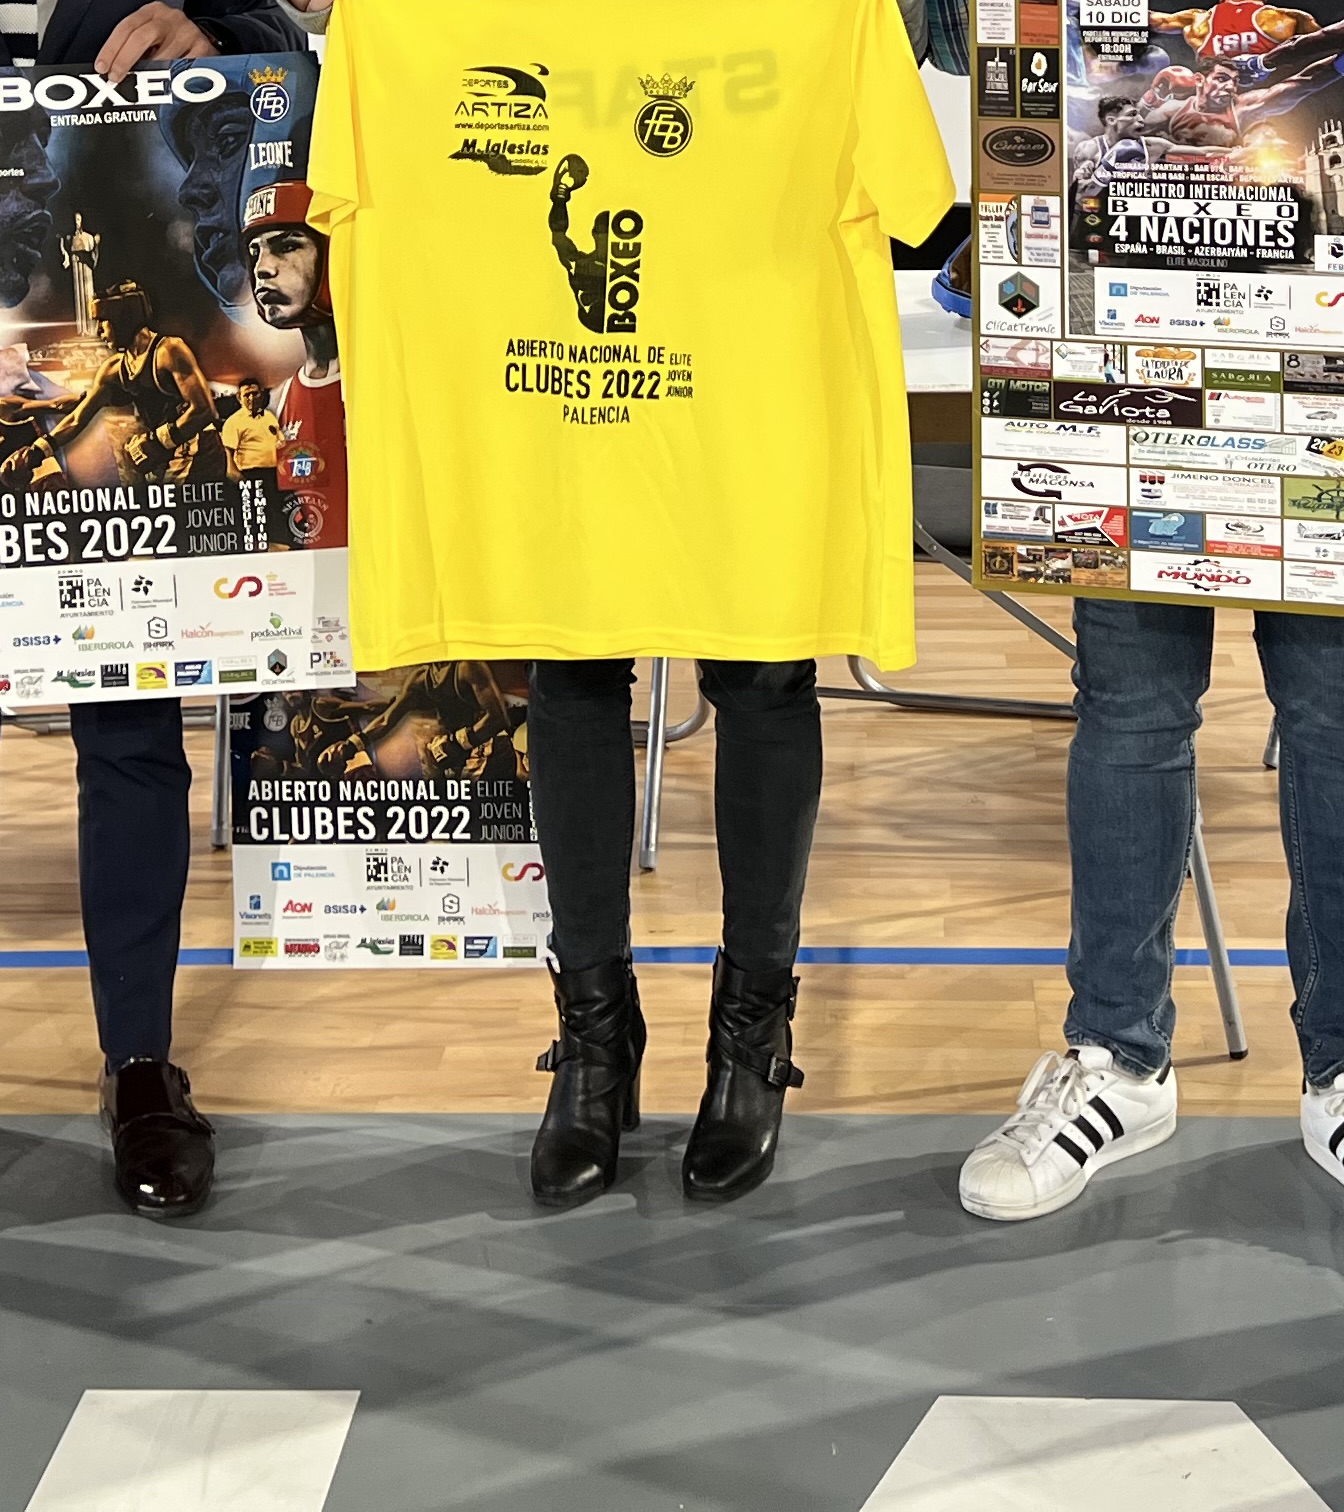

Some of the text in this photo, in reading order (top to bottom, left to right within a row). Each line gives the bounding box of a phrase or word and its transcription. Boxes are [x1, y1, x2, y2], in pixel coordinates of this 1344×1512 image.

[1086, 11, 1141, 24] 10 DIC
[1100, 44, 1132, 54] 18:00H
[1213, 32, 1257, 56] ESP
[462, 78, 509, 89] DEPORTES
[50, 109, 157, 128] ENTRADA GRATUITA
[454, 100, 549, 120] ARTIZA
[454, 121, 550, 132] www.deportesartiza.com
[644, 105, 685, 150] FEB
[248, 140, 294, 171] LEONE
[1109, 181, 1295, 202] ENCUENTRO INTERNACIONAL
[1108, 216, 1295, 248] 4 NACIONES
[1114, 242, 1295, 260] ESPAÑA BRASIL AZERBAIYÁN FRANCIA
[606, 209, 644, 334] BOXEO
[1224, 291, 1246, 300] LEN
[1224, 300, 1244, 308] CIA
[505, 338, 665, 365] ABIERTO NACIONAL DE
[669, 352, 692, 367] ELITE
[505, 362, 662, 400] CLUBES 2022
[665, 369, 693, 383] JOVEN
[1146, 369, 1184, 381] LAURA
[665, 385, 694, 399] JUNIOR
[1009, 380, 1050, 393] MOTOR
[563, 403, 631, 425] PALENCIA
[1004, 421, 1049, 429] AUTO
[1247, 462, 1297, 473] OTERO
[1171, 472, 1275, 485] JIMENO DONCEL
[25, 485, 141, 516] NACIONAL
[148, 483, 177, 509] DE
[182, 482, 225, 504] ELITE
[185, 507, 235, 529] JOVEN
[239, 480, 254, 552] MASCULINO
[254, 479, 268, 551] FEMENINO
[81, 515, 178, 559] 2022
[187, 531, 238, 554] JUNIOR
[86, 577, 103, 588] PA
[1157, 569, 1252, 586] MUNDO
[87, 587, 111, 598] LEN
[87, 597, 109, 608] CIA
[12, 635, 51, 647] asisa
[78, 641, 134, 652] IBERDROLA
[247, 779, 472, 802] ABIERTO NACIONAL DE
[477, 780, 514, 798] ELITE
[478, 802, 522, 820] JOVEN
[249, 805, 471, 841] CLUBES 2022
[479, 824, 525, 841] JUNIOR
[391, 865, 412, 874] LEN
[391, 874, 410, 883] CIA
[324, 904, 358, 914] asisa
